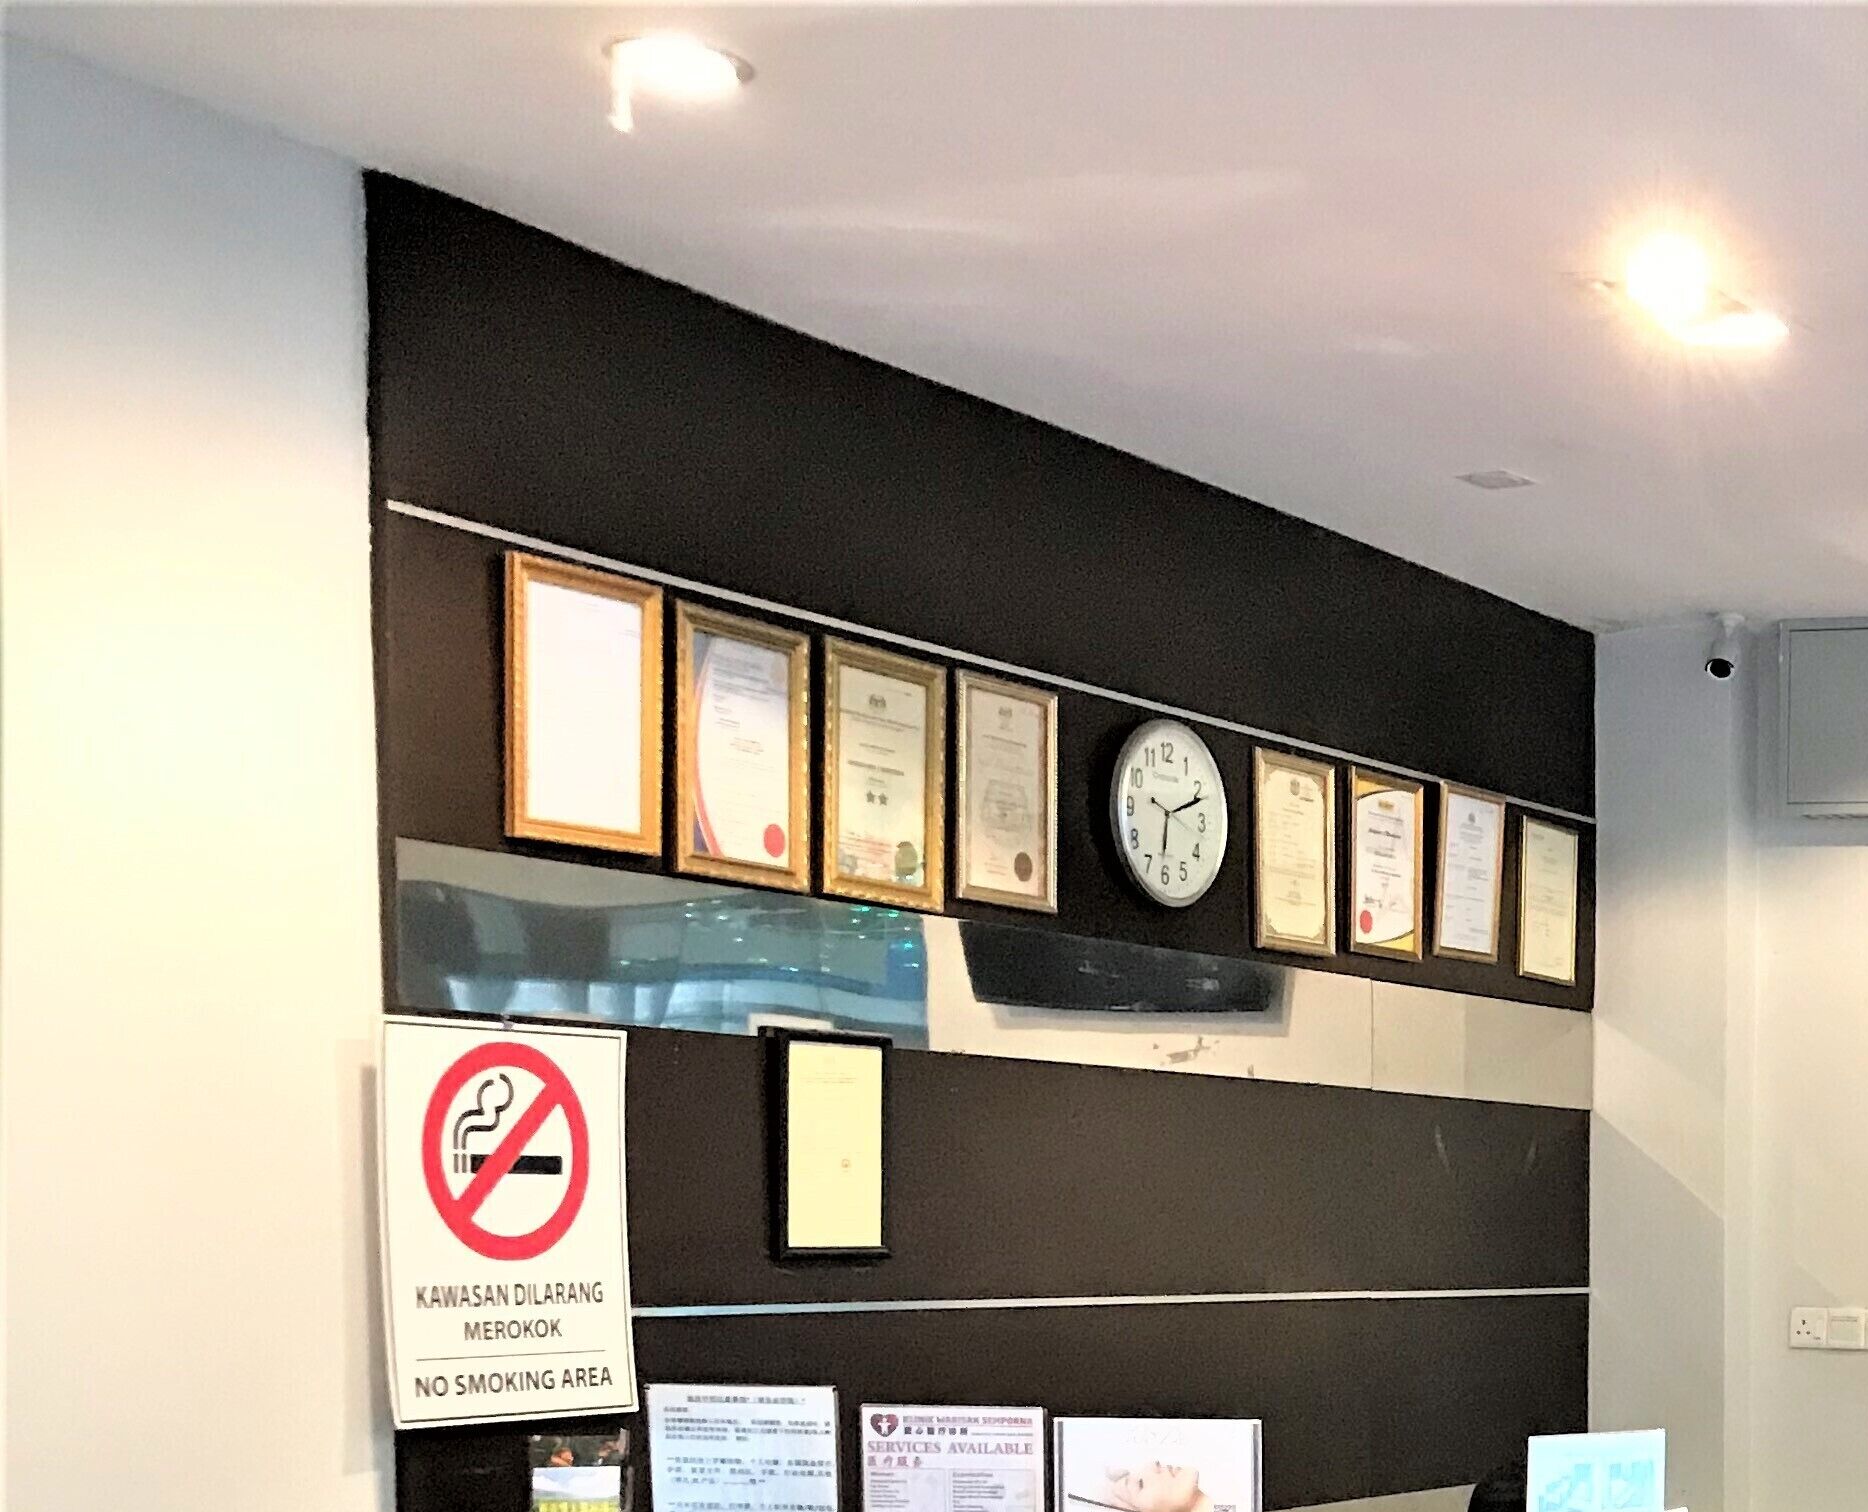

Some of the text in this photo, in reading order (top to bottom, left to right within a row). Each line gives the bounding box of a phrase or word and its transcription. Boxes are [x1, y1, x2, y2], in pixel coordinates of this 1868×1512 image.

[1145, 748, 1155, 767] 11
[1161, 742, 1173, 763] 12
[1184, 757, 1188, 776] 1
[1131, 768, 1143, 788] 10
[1194, 781, 1202, 798] 2
[1127, 796, 1134, 816] 9
[1199, 813, 1206, 832] 3
[1130, 828, 1138, 849] 8
[1192, 843, 1200, 861] 4
[1144, 854, 1152, 873] 7
[1179, 862, 1188, 881] 5
[1161, 865, 1169, 885] 6
[415, 1282, 603, 1308] KAWASAN DILARANG
[464, 1319, 562, 1340] MEROKOK
[415, 1367, 612, 1397] NO SMOKING AREA
[868, 1441, 1033, 1455] SERVICES AVAILABLE
